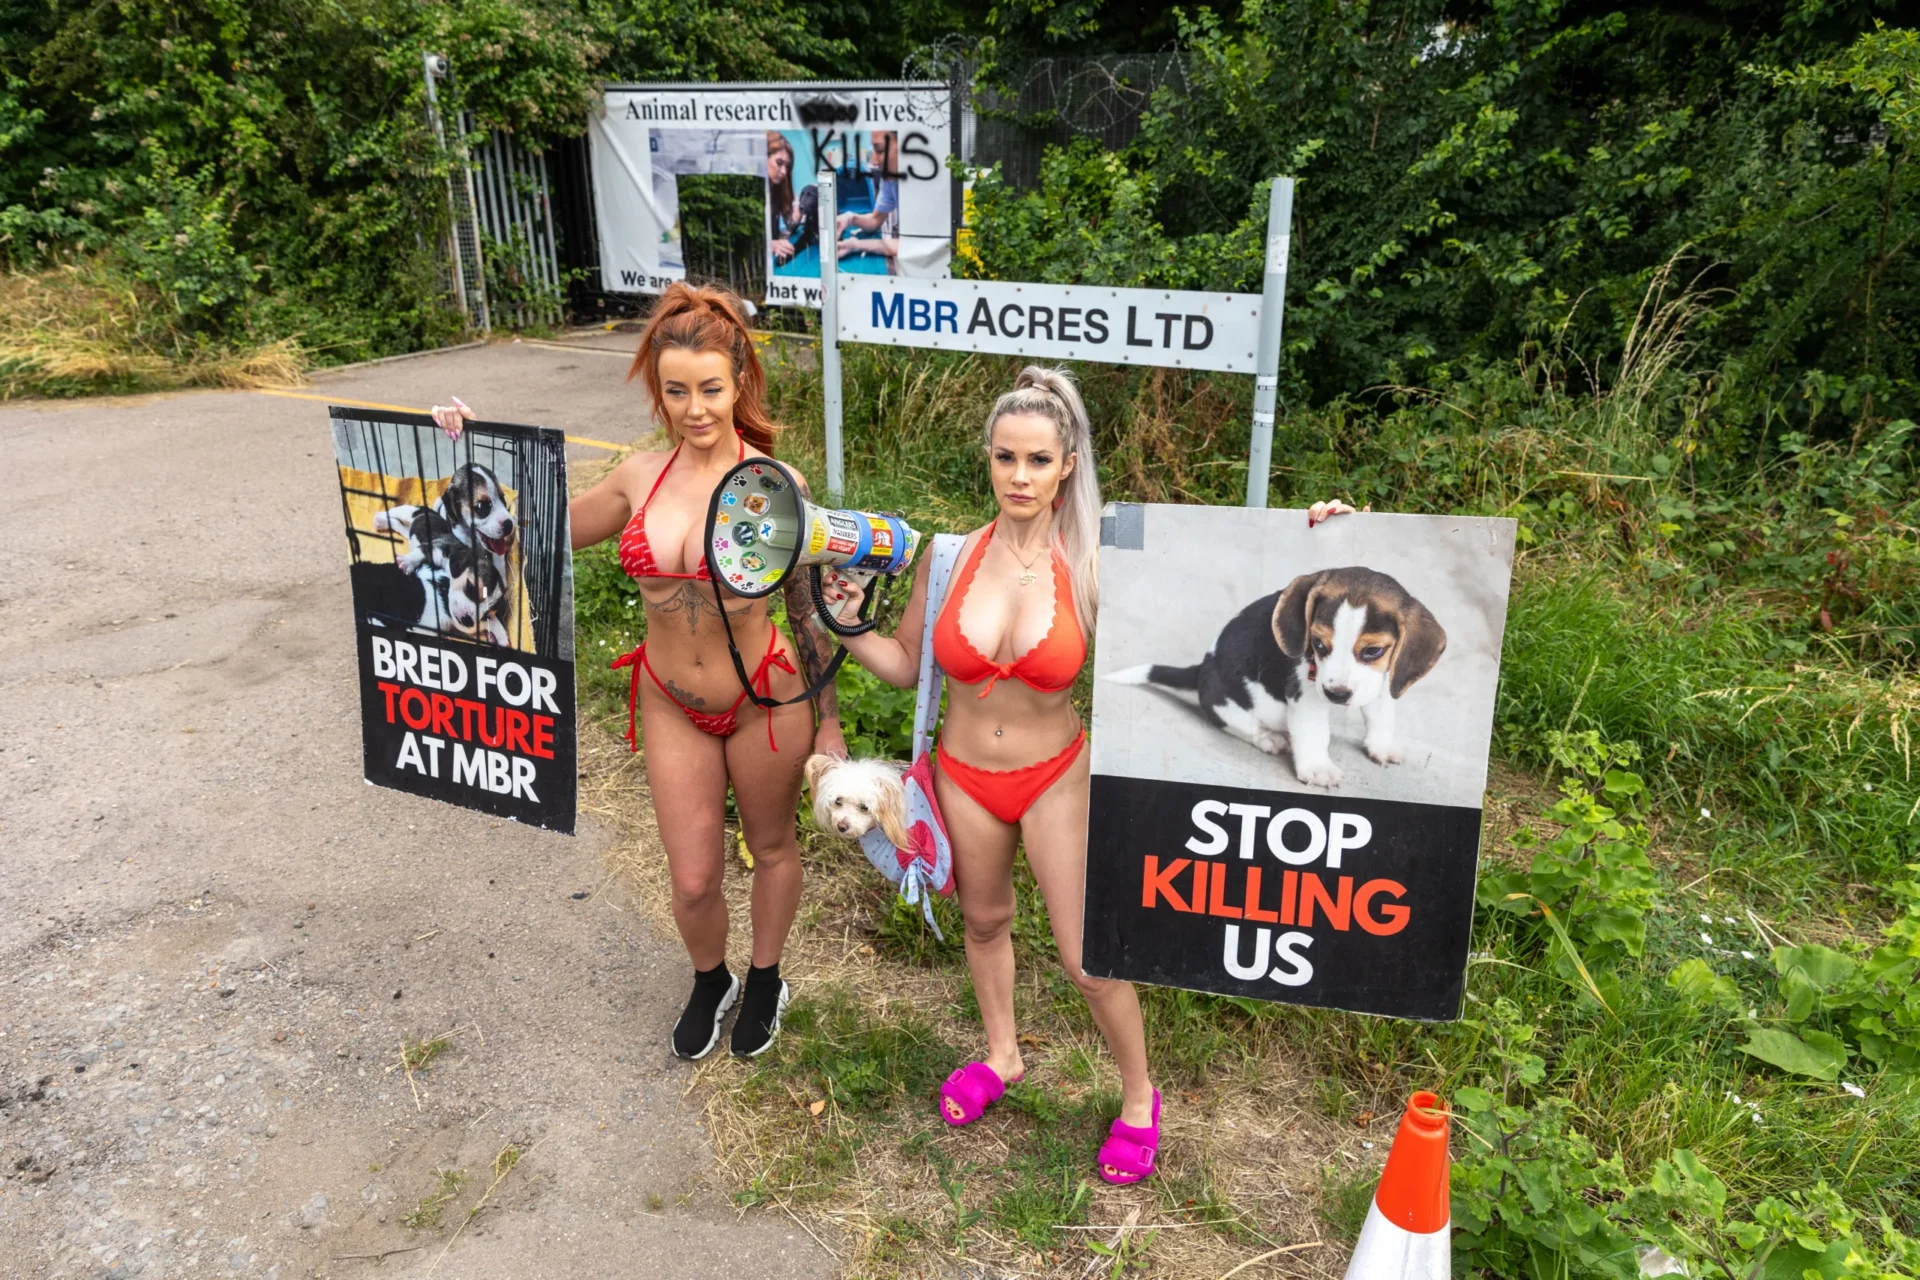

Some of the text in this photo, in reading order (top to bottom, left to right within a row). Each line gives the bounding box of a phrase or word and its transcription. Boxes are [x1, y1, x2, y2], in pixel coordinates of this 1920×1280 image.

[626, 98, 697, 121] Animal
[704, 98, 793, 122] research
[865, 98, 923, 123] lives.
[811, 127, 939, 181] KILLS
[620, 270, 646, 287] We
[650, 275, 673, 288] are
[767, 281, 798, 300] hat
[871, 291, 1214, 351] MBR ACRES LTD
[371, 635, 562, 715] BRED FOR
[377, 681, 555, 760] TORTURE
[395, 731, 541, 804] AT MBR
[1184, 799, 1373, 869] STOP
[1142, 854, 1411, 936] KILLING
[1223, 924, 1315, 987] US
